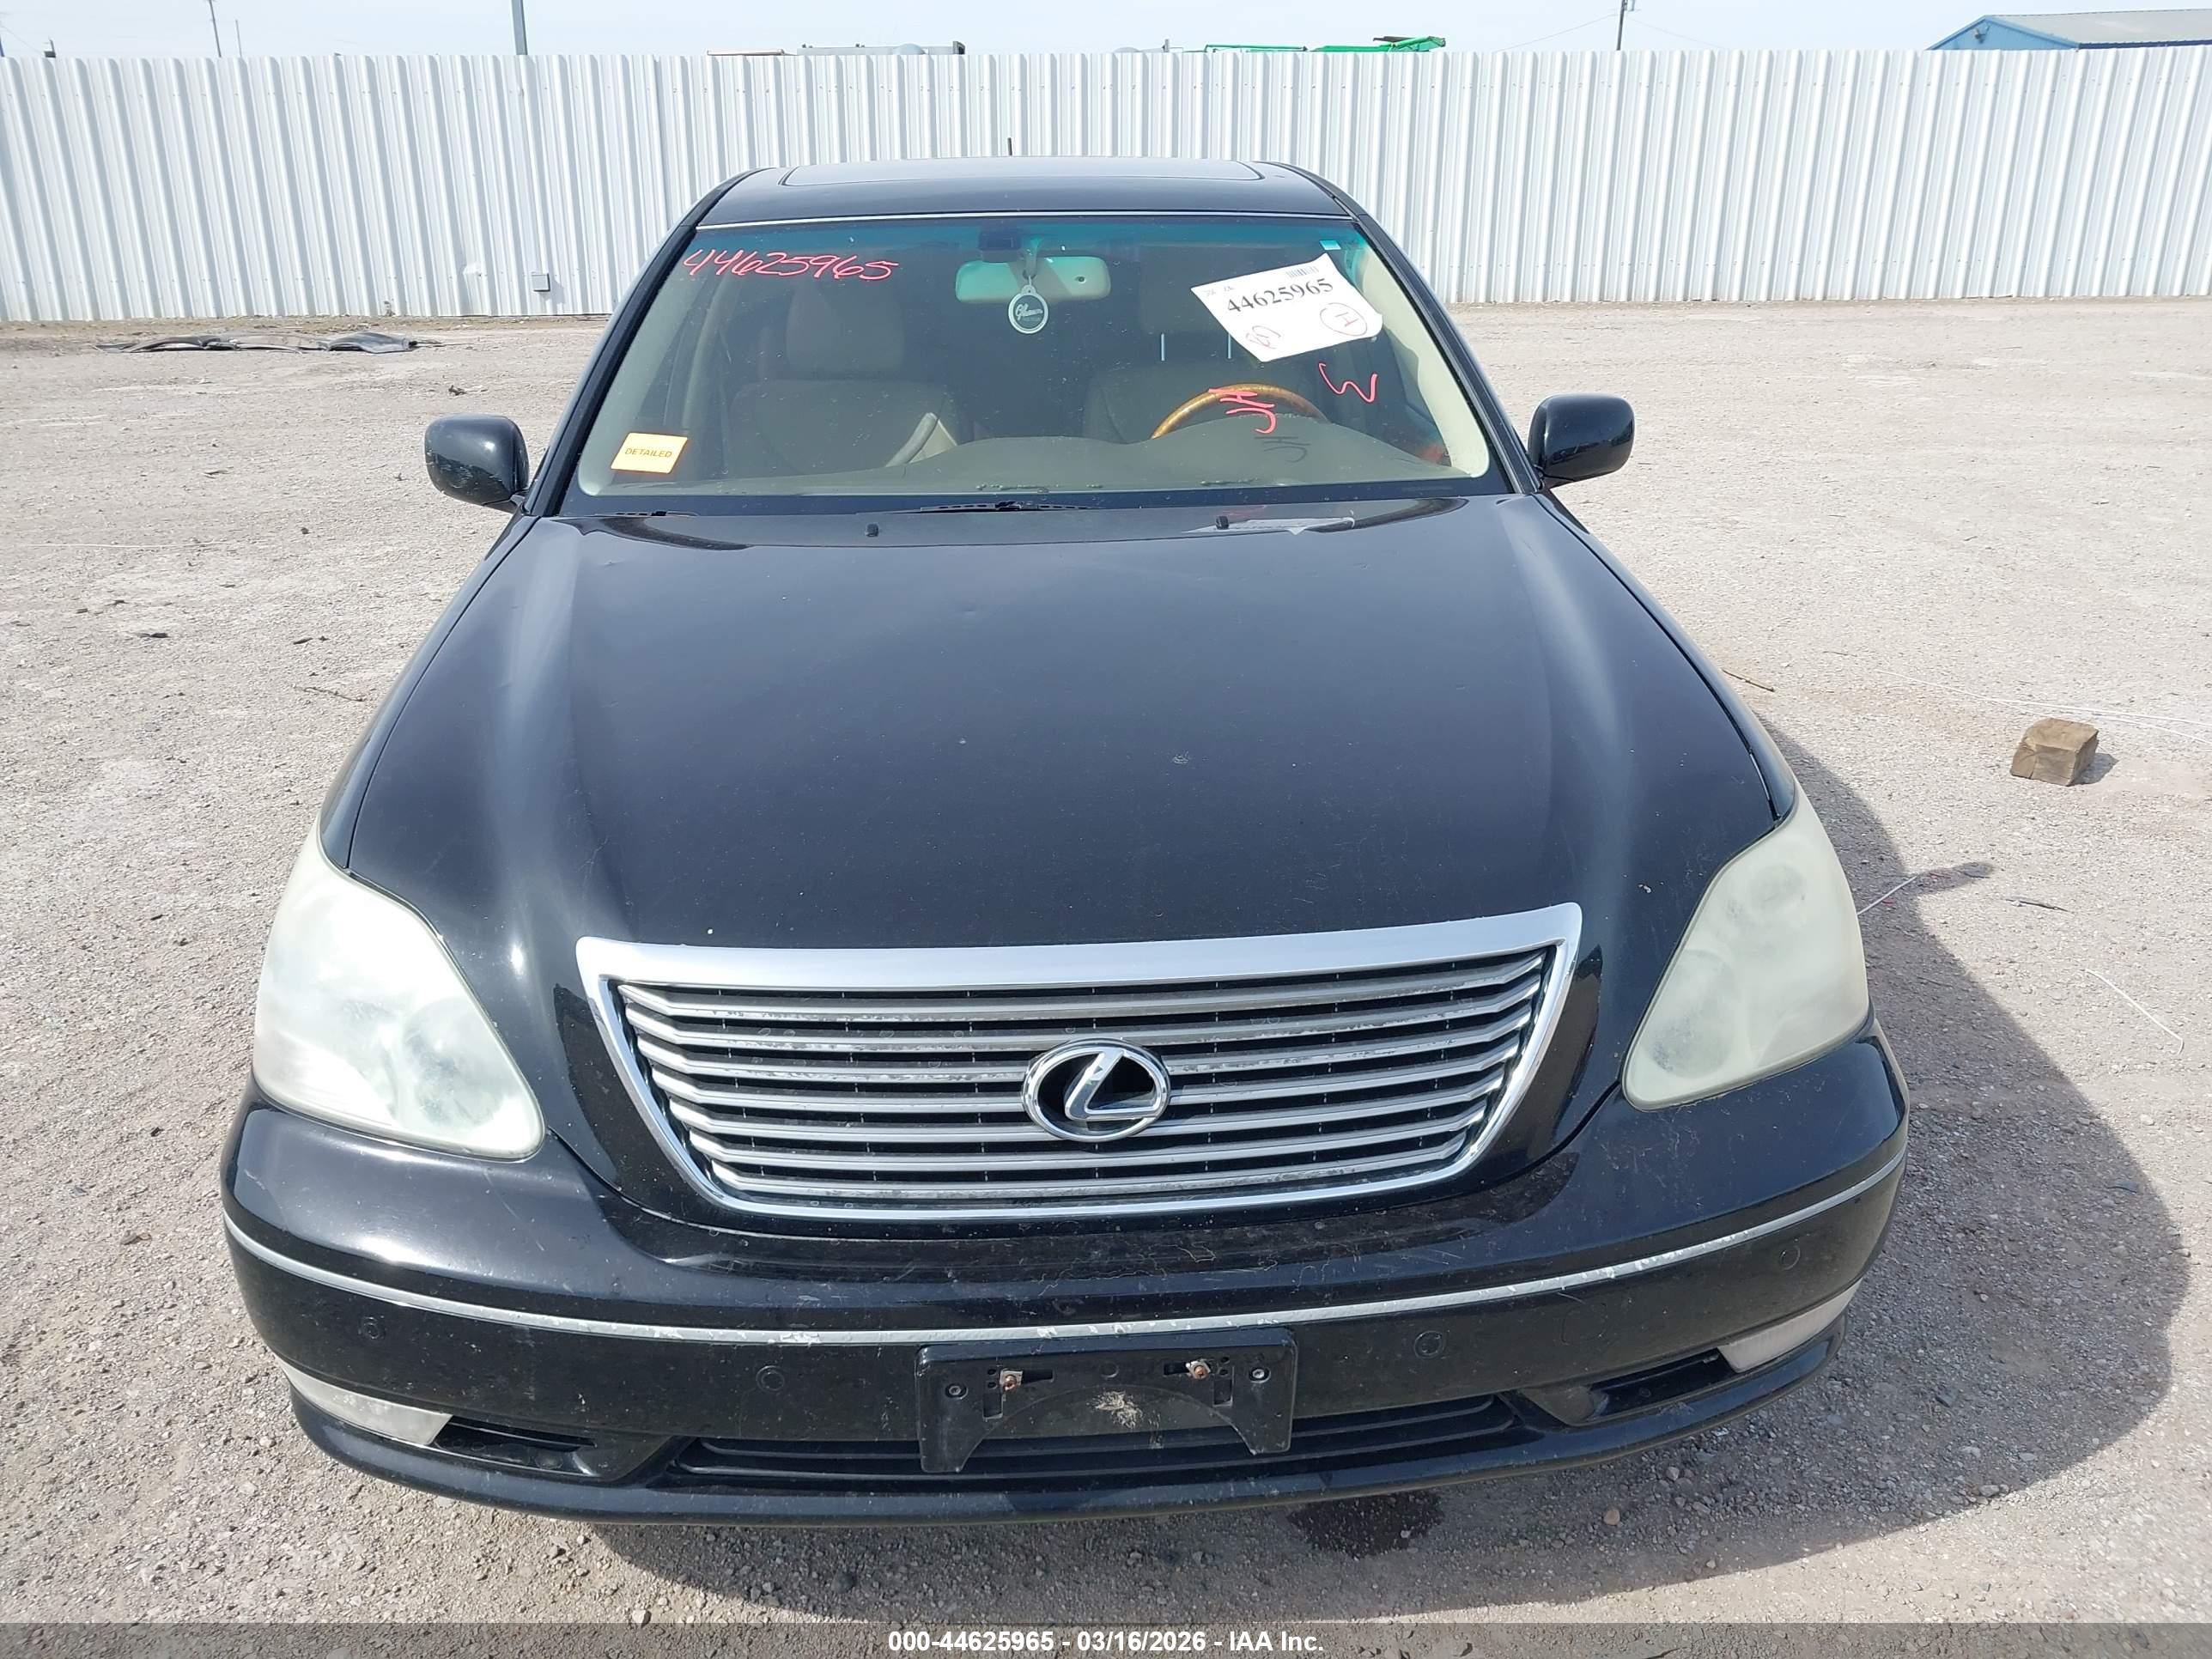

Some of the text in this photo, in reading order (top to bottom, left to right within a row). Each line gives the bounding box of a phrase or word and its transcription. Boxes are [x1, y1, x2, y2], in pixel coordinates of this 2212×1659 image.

[684, 249, 899, 281] 44625965
[1227, 277, 1334, 313] 44625965
[624, 447, 673, 458] DETAILED
